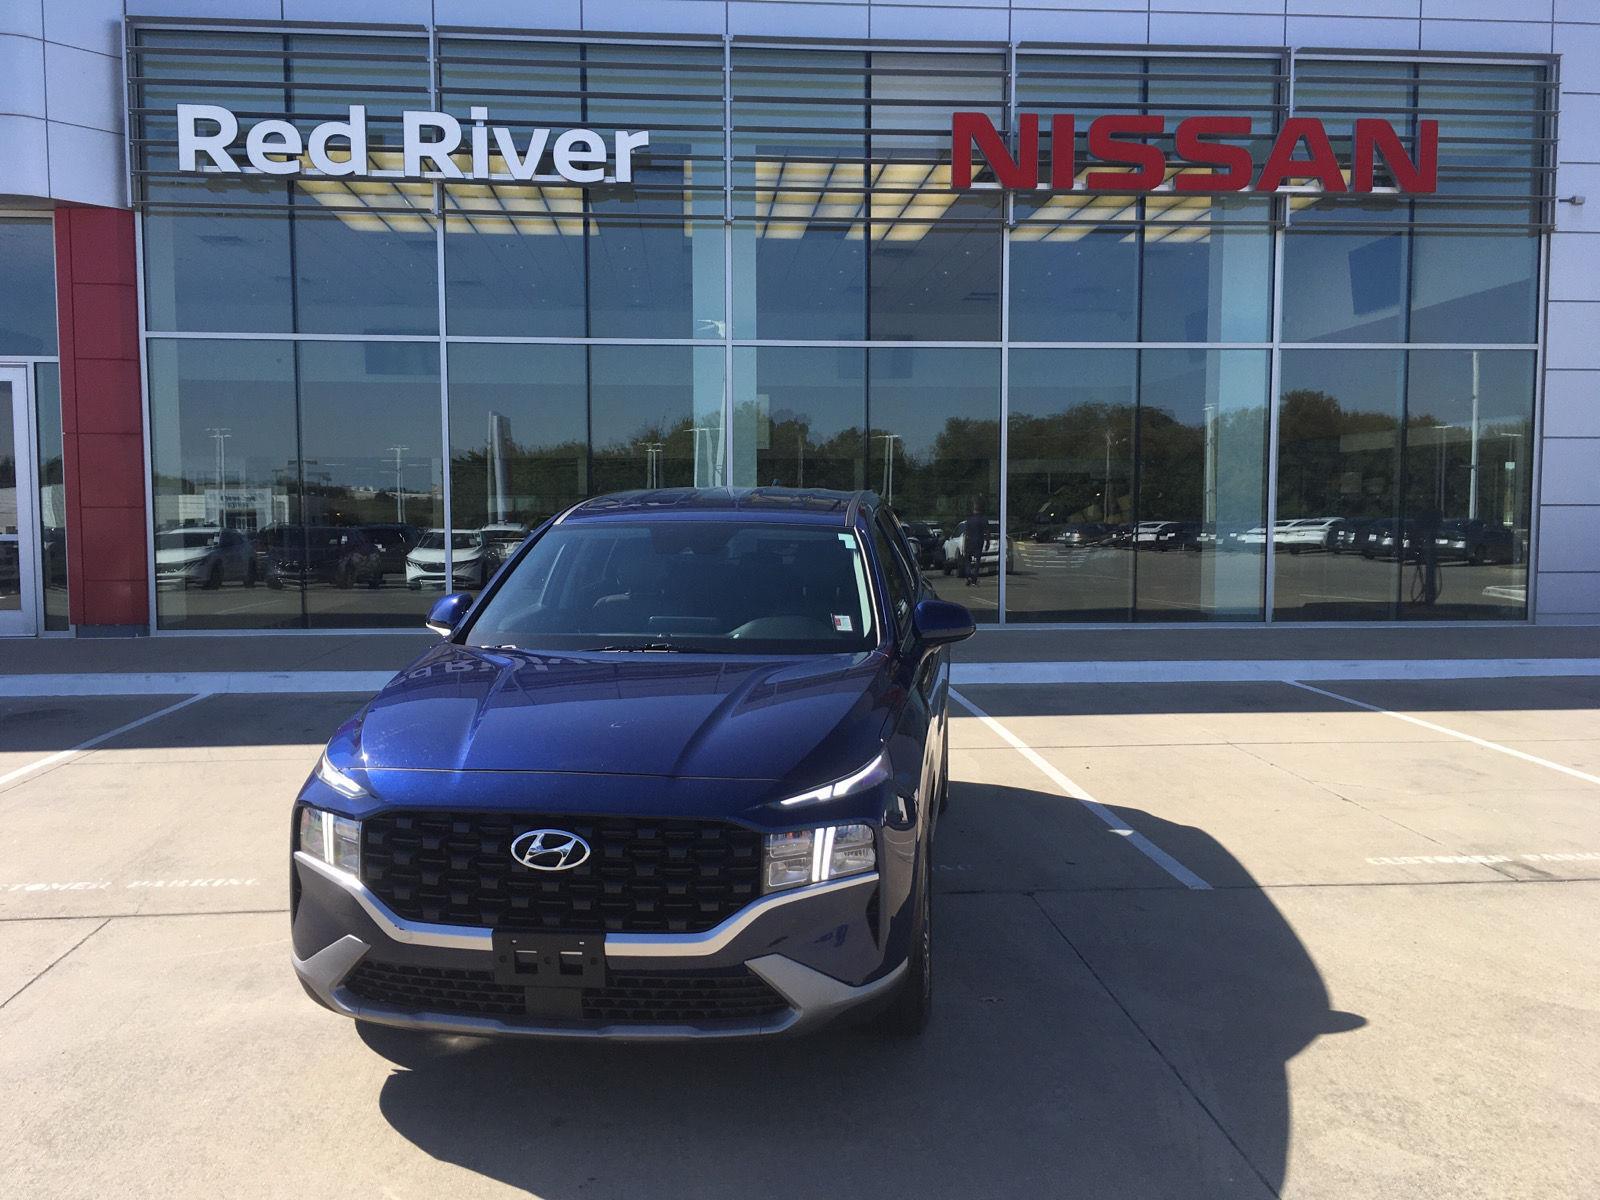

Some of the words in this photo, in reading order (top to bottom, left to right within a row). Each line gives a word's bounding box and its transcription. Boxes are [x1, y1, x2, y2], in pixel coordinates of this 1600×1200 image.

[176, 104, 368, 176] Red
[402, 106, 649, 184] River
[952, 112, 1438, 193] NISSAN
